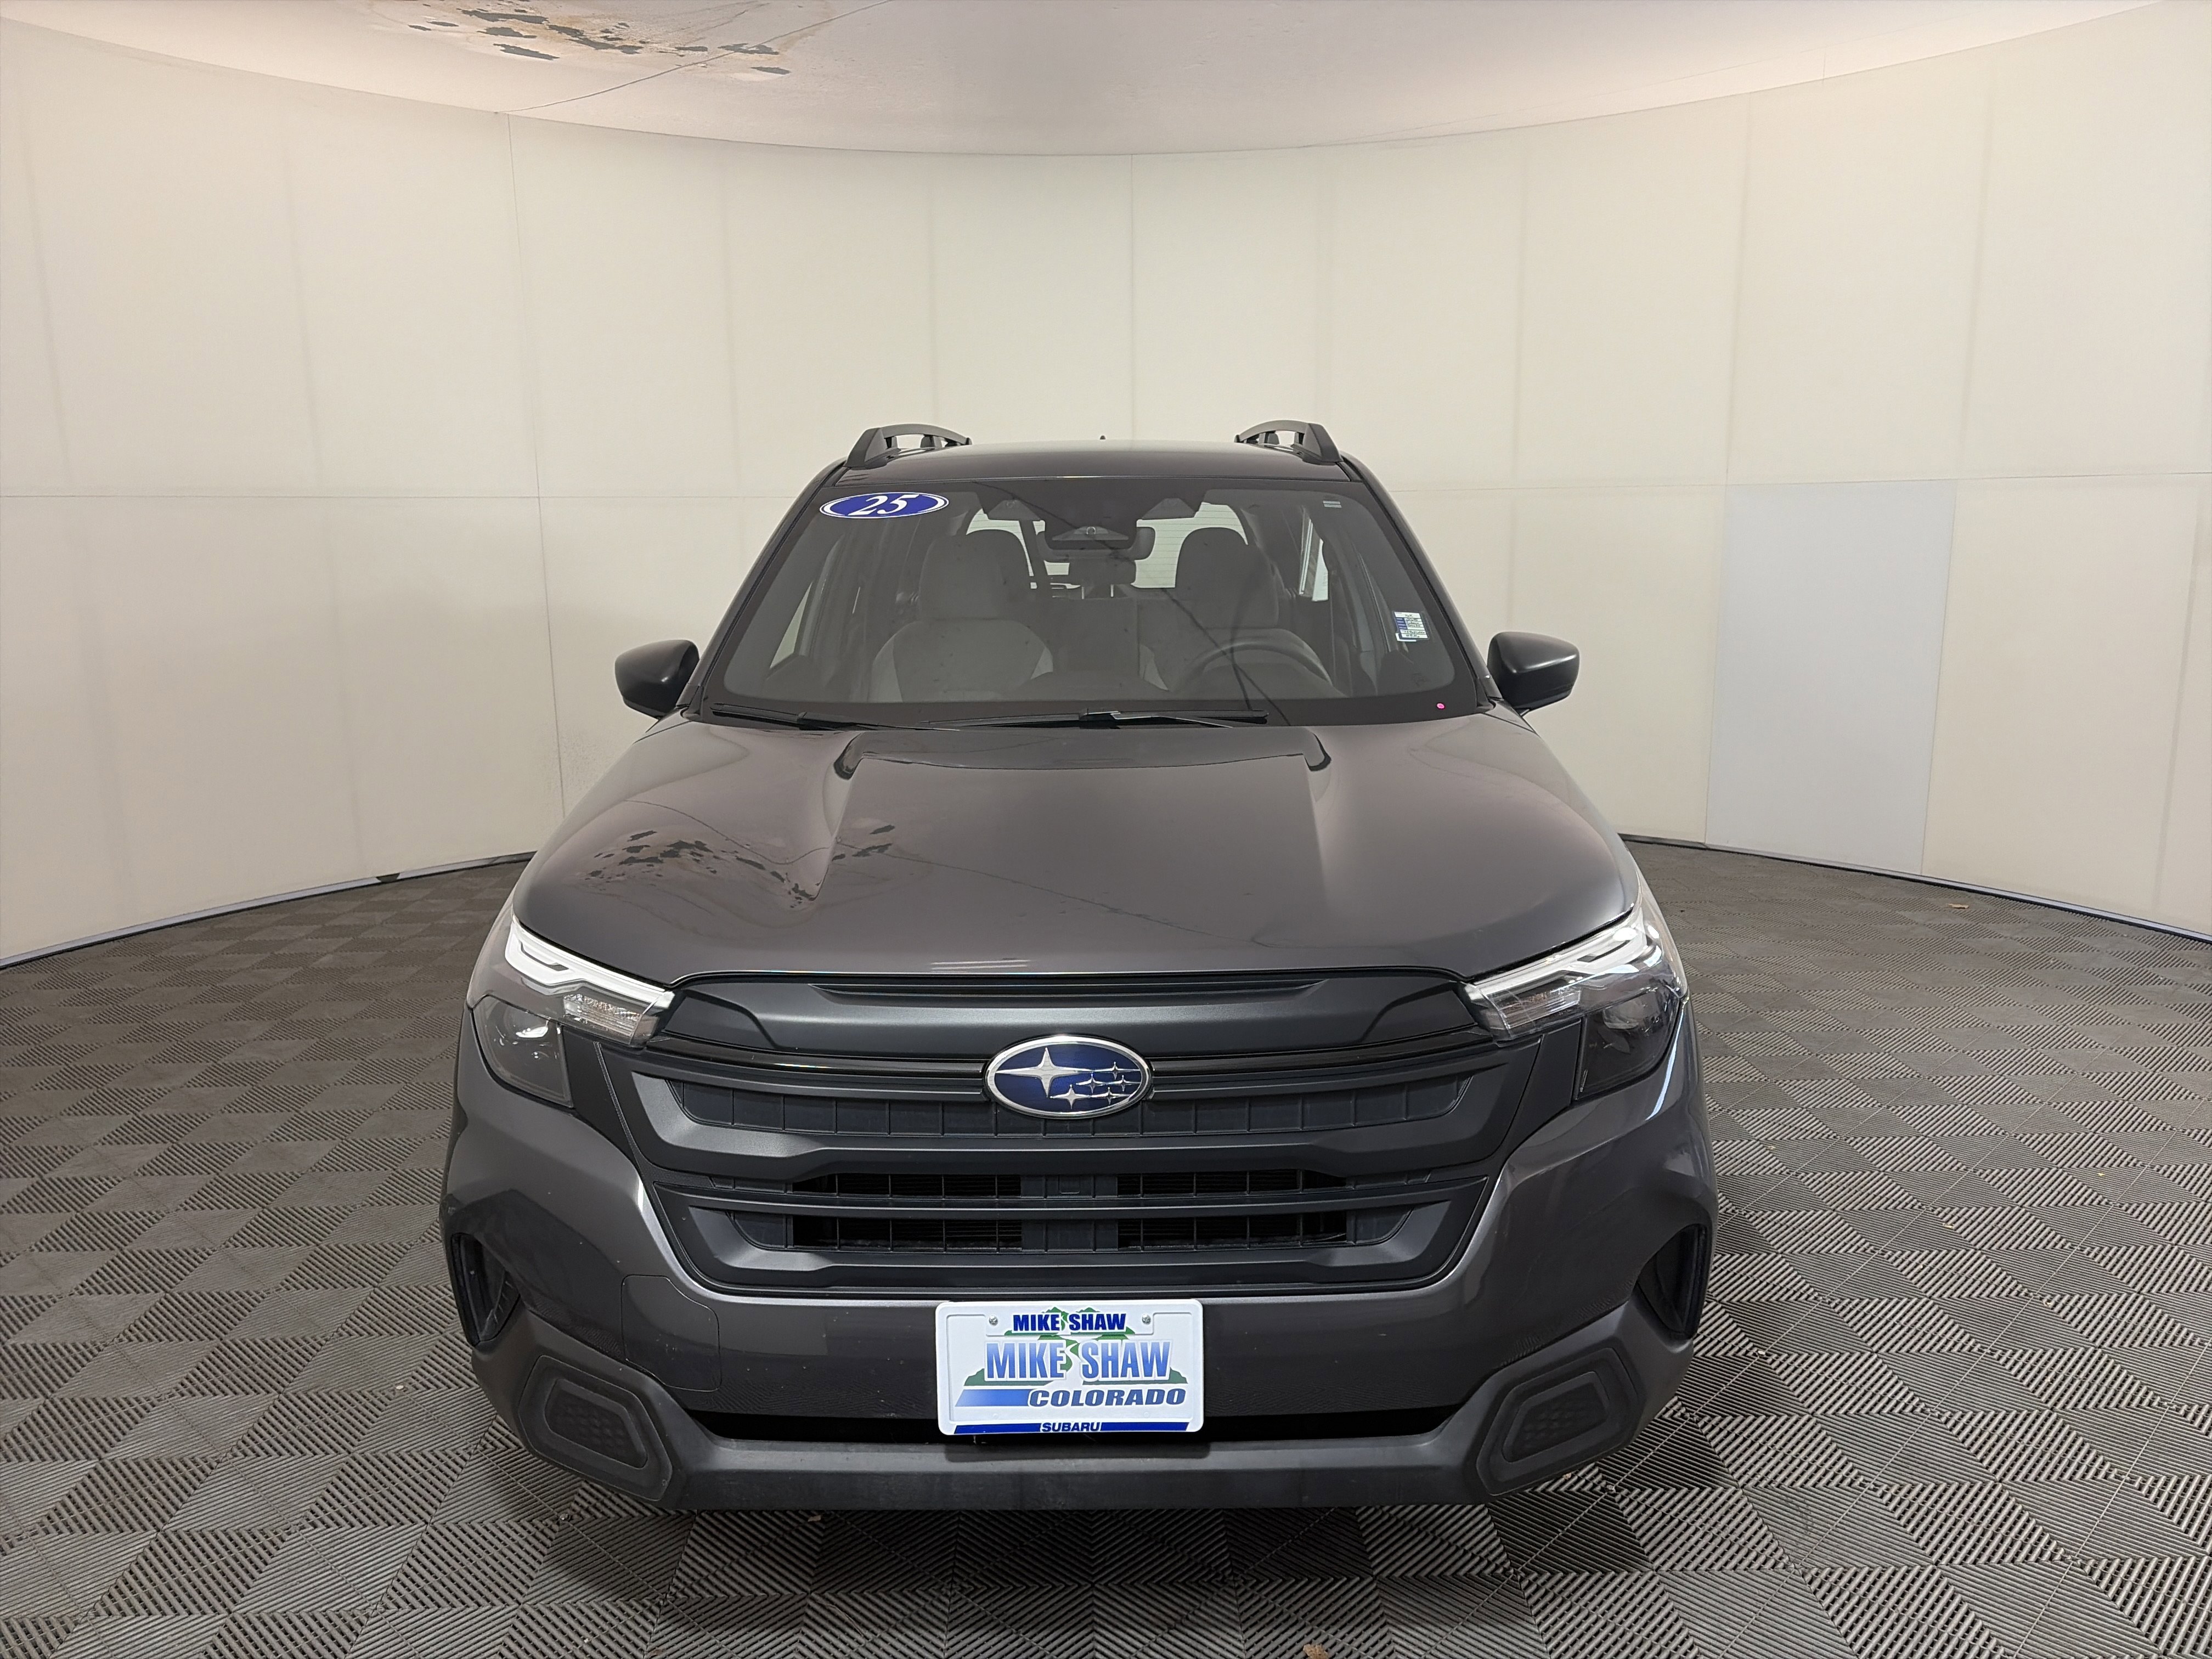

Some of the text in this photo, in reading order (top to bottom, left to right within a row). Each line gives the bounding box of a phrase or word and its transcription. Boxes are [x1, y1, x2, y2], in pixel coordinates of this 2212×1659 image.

[848, 494, 919, 516] 25
[1013, 1313, 1127, 1331] MIKE SHAW
[986, 1341, 1171, 1379] MIKE SHAW
[1029, 1388, 1187, 1407] COLORADO
[1041, 1421, 1101, 1432] SUBARU
